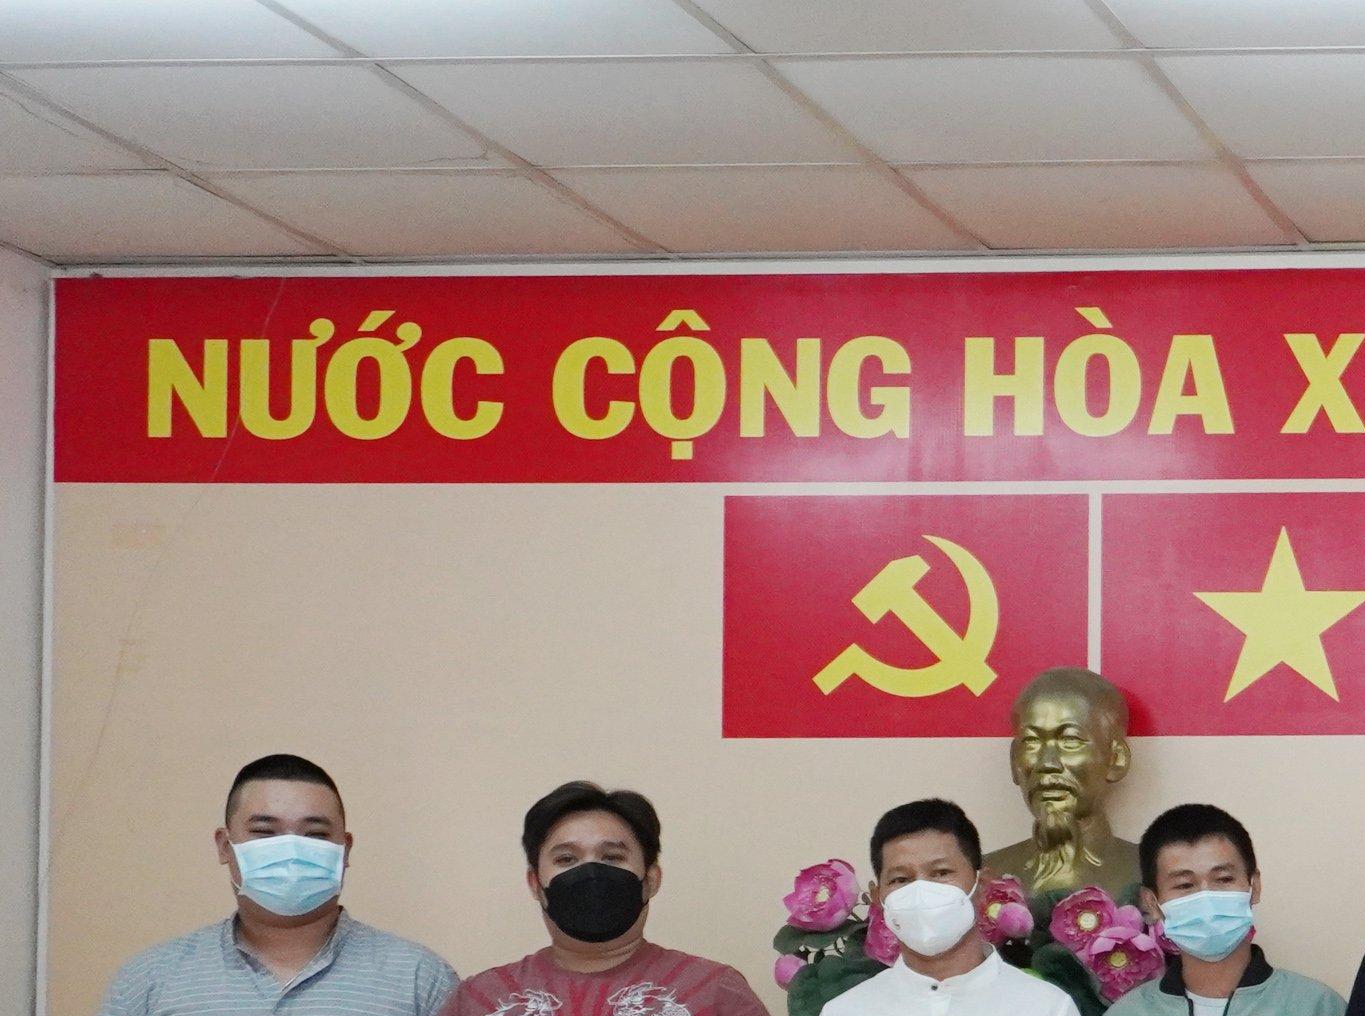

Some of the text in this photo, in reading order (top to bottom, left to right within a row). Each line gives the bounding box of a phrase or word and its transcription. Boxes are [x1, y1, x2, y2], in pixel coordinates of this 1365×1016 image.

[147, 310, 504, 440] NƯỚC
[552, 309, 910, 460] CỘNG
[965, 306, 1234, 436] HÒA
